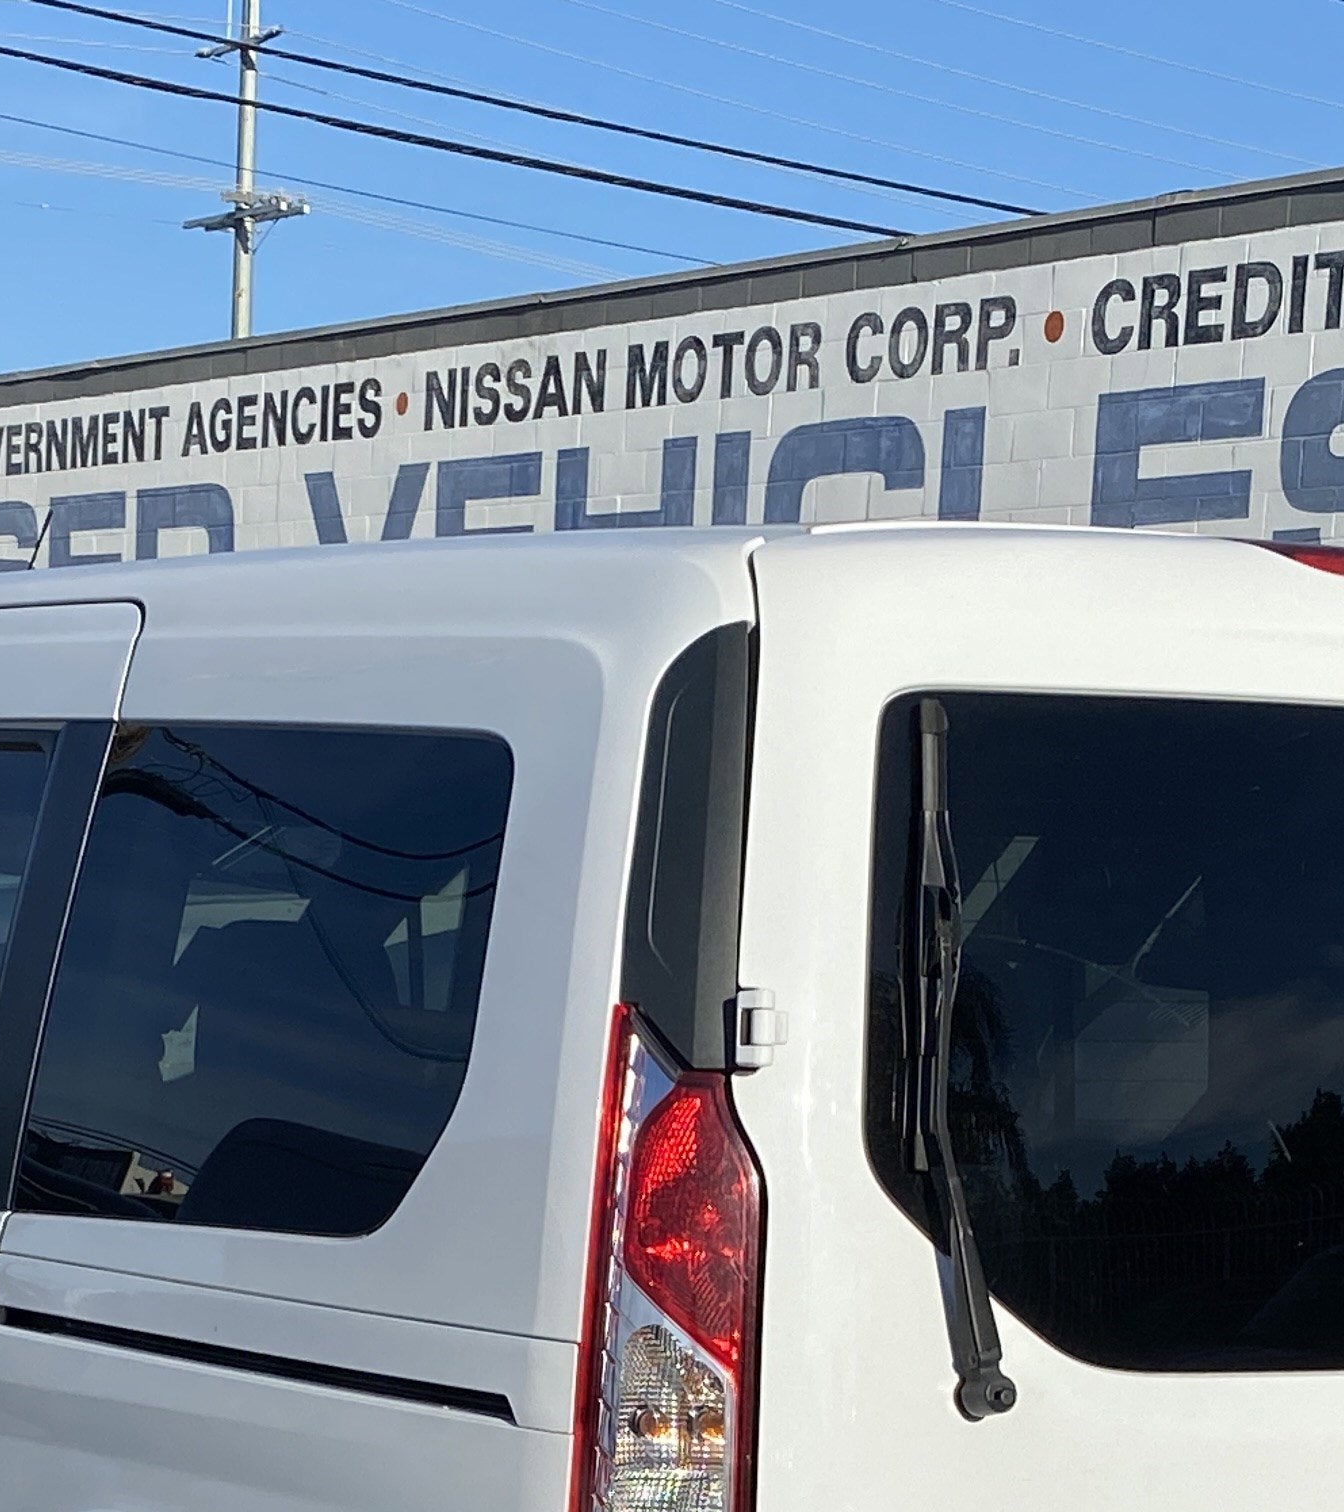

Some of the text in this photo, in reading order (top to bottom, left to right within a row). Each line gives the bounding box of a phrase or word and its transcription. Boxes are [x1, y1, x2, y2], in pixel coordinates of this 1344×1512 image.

[182, 378, 382, 456] AGENCIES
[423, 349, 607, 431] NISSAN
[626, 321, 823, 409] MOTOR
[845, 295, 1019, 383] CORP.
